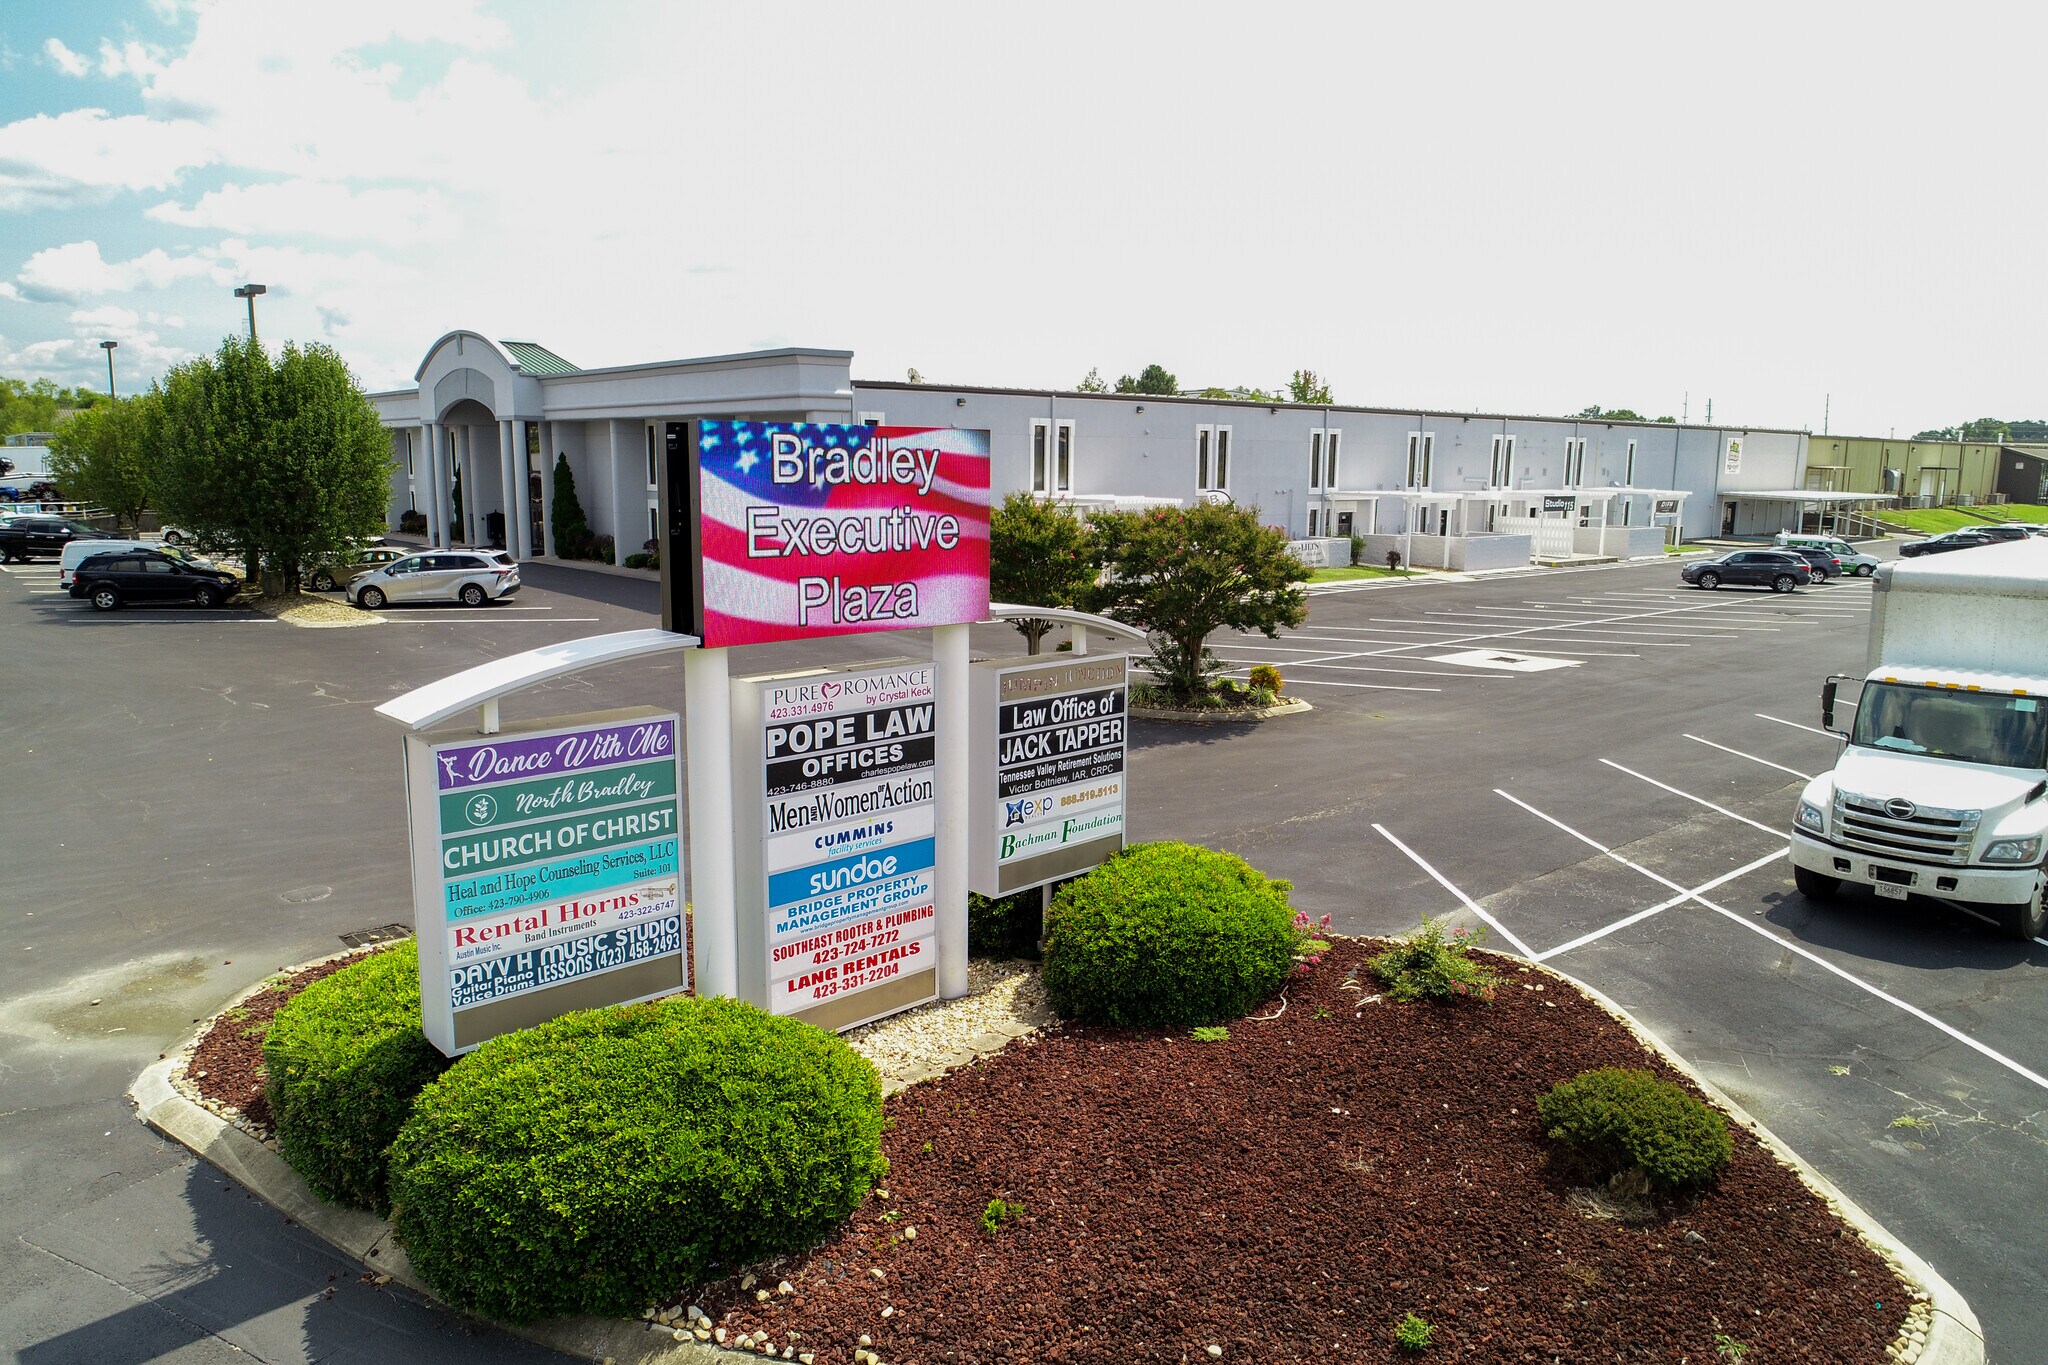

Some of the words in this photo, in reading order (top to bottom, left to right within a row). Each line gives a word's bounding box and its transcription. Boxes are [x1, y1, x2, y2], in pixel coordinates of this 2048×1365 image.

[772, 432, 940, 496] Bradley
[1545, 499, 1564, 508] Studio
[1563, 501, 1574, 511] 115
[746, 505, 960, 559] Executive
[798, 575, 918, 626] Plaza
[774, 685, 819, 705] PURE
[844, 670, 928, 696] ROMANCE
[866, 694, 876, 705] by
[879, 689, 908, 703] Crystal
[911, 686, 932, 697] Keck
[770, 701, 833, 719] 423.331.4976
[1013, 706, 1046, 730] Law
[1050, 697, 1096, 723] Office
[1100, 691, 1115, 714] of
[767, 717, 855, 757] POPE
[867, 706, 933, 740] LAW
[1001, 732, 1052, 763] JACK
[1056, 719, 1122, 752] TAPPER
[468, 748, 552, 782] Dance
[556, 733, 624, 767] With
[628, 724, 669, 756] Me
[802, 744, 903, 777] OFFICES
[861, 759, 933, 778] charlespopelaw.com
[1000, 769, 1035, 784] Tennessee
[1036, 763, 1056, 776] Valley
[1057, 756, 1092, 771] Retirement
[1093, 751, 1121, 763] Solutions
[516, 780, 574, 814] North
[578, 773, 655, 802] Bradley
[767, 778, 834, 796] 423-746-8880
[878, 785, 886, 793] OF
[881, 778, 933, 808] Action
[1009, 784, 1033, 795] Victor
[1090, 764, 1113, 776] CRPC
[1060, 784, 1119, 807] 888.519.5113
[770, 802, 810, 832] Men
[815, 791, 879, 822] Women
[1024, 796, 1053, 816] exp
[444, 830, 551, 869] CHURCH
[557, 823, 589, 847] OF
[592, 808, 673, 841] CHRIST
[815, 821, 893, 849] CUMMINS
[828, 844, 854, 858] facility
[855, 837, 882, 850] services
[999, 830, 1057, 860] Bachman
[1060, 813, 1122, 844] Foundation
[448, 881, 479, 902] Heal
[481, 878, 502, 895] and
[504, 872, 537, 891] Hope
[540, 860, 600, 882] Counseling
[602, 850, 647, 871] Services,
[649, 842, 674, 860] LLC
[633, 868, 656, 879] Suite:
[659, 863, 671, 874] 101
[810, 855, 897, 894] sundae
[454, 904, 486, 918] Office:
[488, 889, 550, 911] 423-790-4906
[618, 900, 675, 921] 423-322-6747
[776, 898, 878, 933] MANAGEMENT
[883, 884, 928, 903] GROUP
[788, 895, 843, 918] BRIDGE
[848, 875, 919, 902] PROPERTY
[453, 909, 549, 948] Rental
[558, 891, 639, 923] Horns
[524, 931, 547, 944] Band
[549, 918, 597, 937] Instruments
[773, 933, 833, 962] SOUTHEAST
[836, 921, 873, 944] ROOTER
[876, 919, 883, 931] &
[885, 905, 933, 928] PLUMBING
[451, 956, 511, 988] DAYV
[517, 954, 533, 972] H
[541, 934, 608, 964] MUSIC
[615, 917, 680, 946] STUDIO
[456, 949, 474, 959] Austin
[475, 945, 491, 954] Music
[492, 943, 502, 951] Inc.
[537, 953, 593, 984] LESSONS
[596, 945, 626, 969] (423)
[629, 933, 680, 960] 458-2493
[812, 929, 899, 965] 423-724-7272
[788, 967, 838, 993] LANG
[843, 941, 920, 976] RENTALS
[813, 963, 899, 999] 423-331-2204
[452, 982, 492, 997] Guitar
[494, 972, 534, 987] Piano
[452, 991, 493, 1006] Voice
[495, 980, 535, 995] Drums
